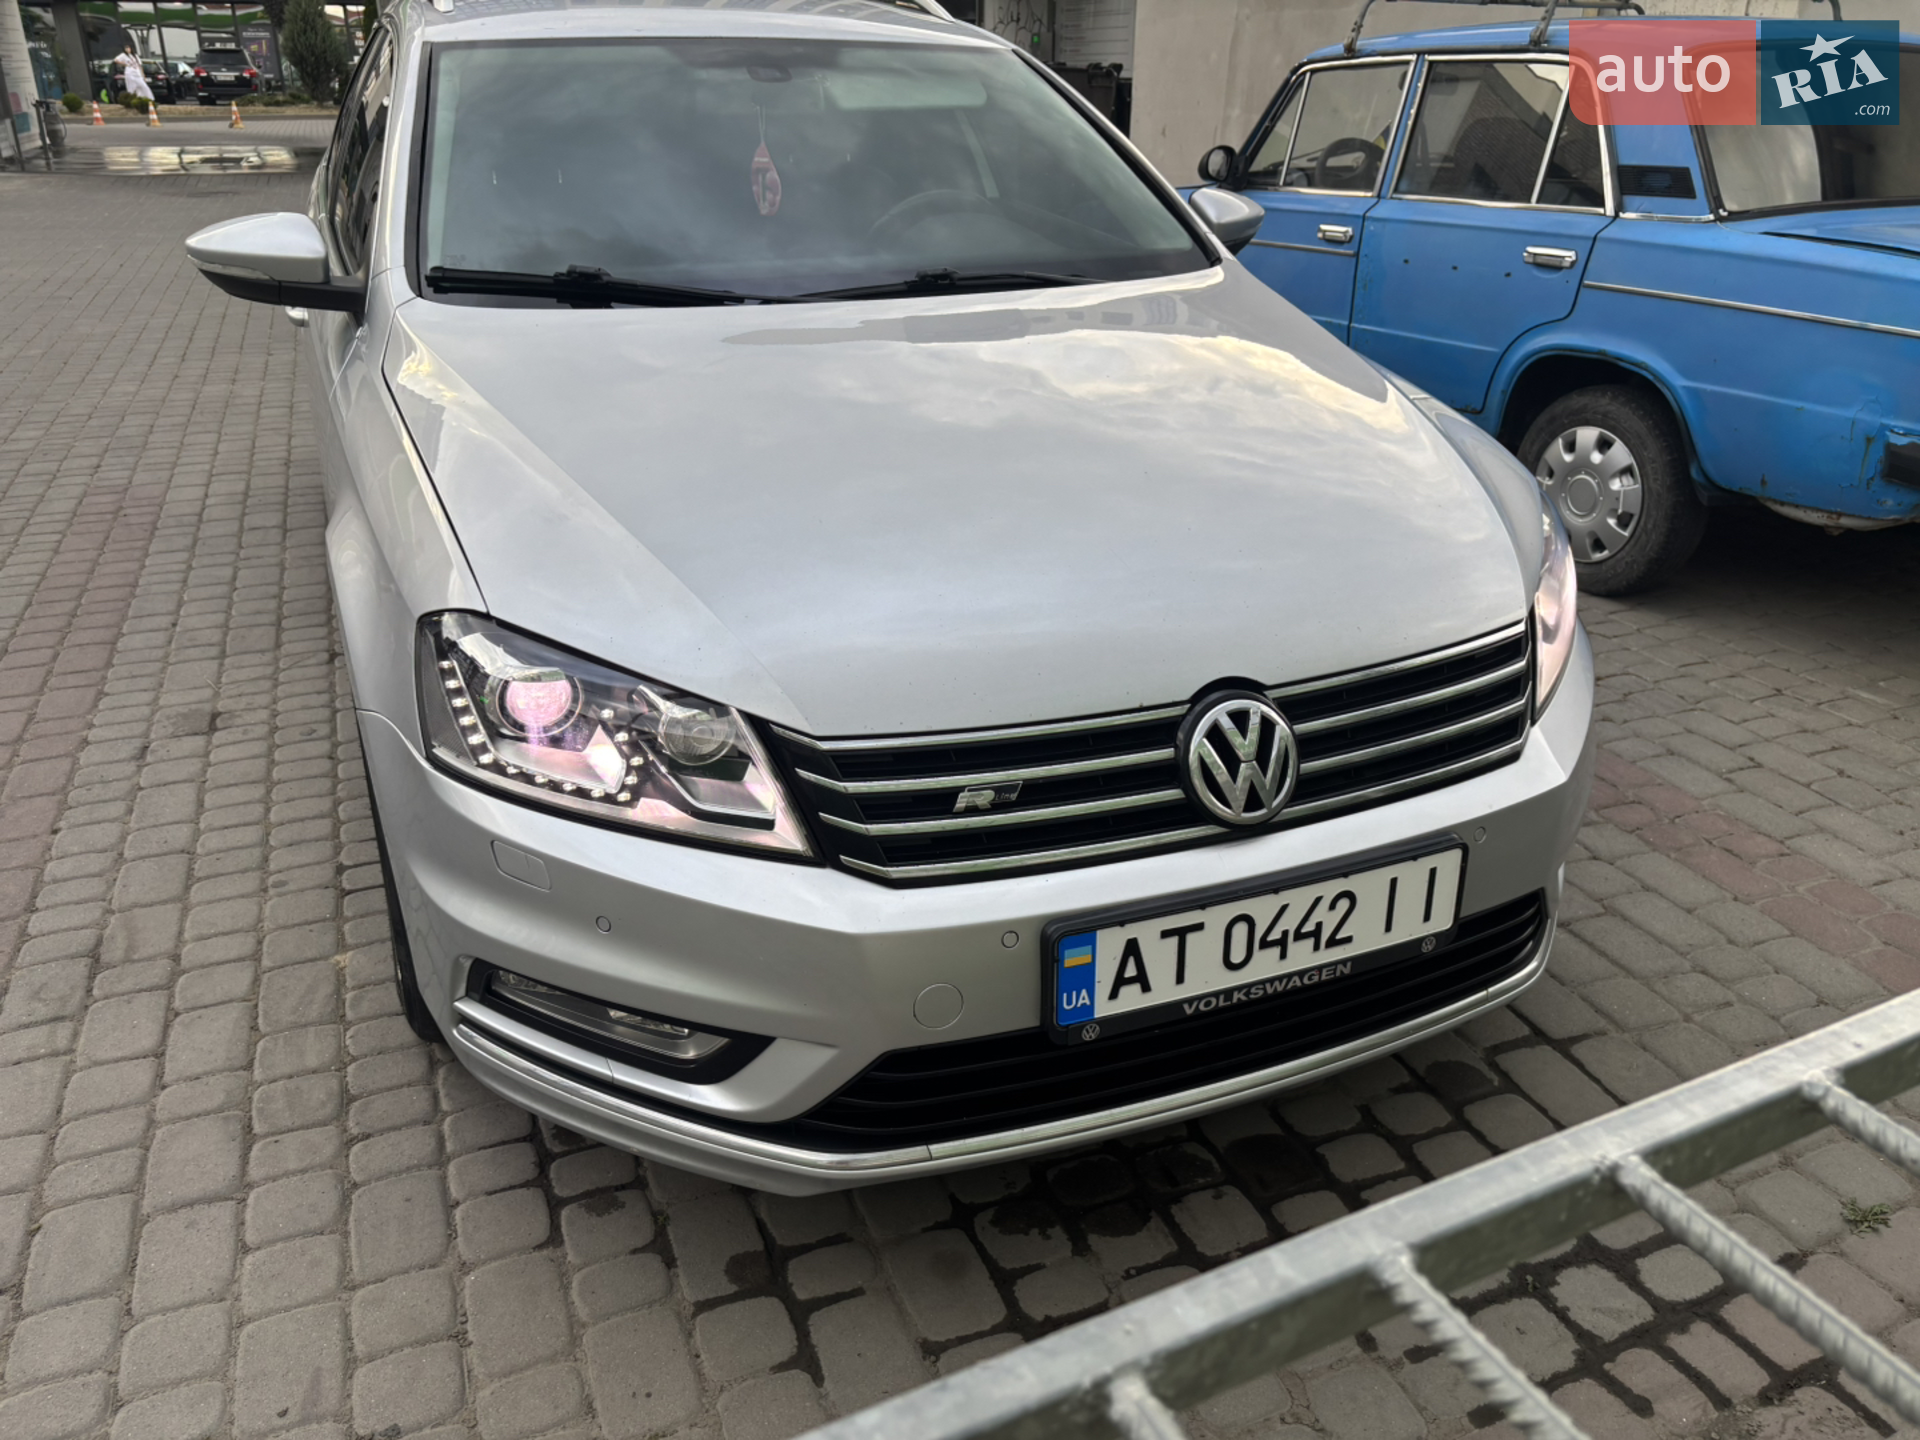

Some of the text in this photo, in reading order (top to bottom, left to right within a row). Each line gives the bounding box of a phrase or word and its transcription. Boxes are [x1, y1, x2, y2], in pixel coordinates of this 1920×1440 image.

[1108, 866, 1438, 1001] AT 0442 II
[1062, 988, 1091, 1010] UA
[1182, 961, 1353, 1016] VOLKSWAGEN
